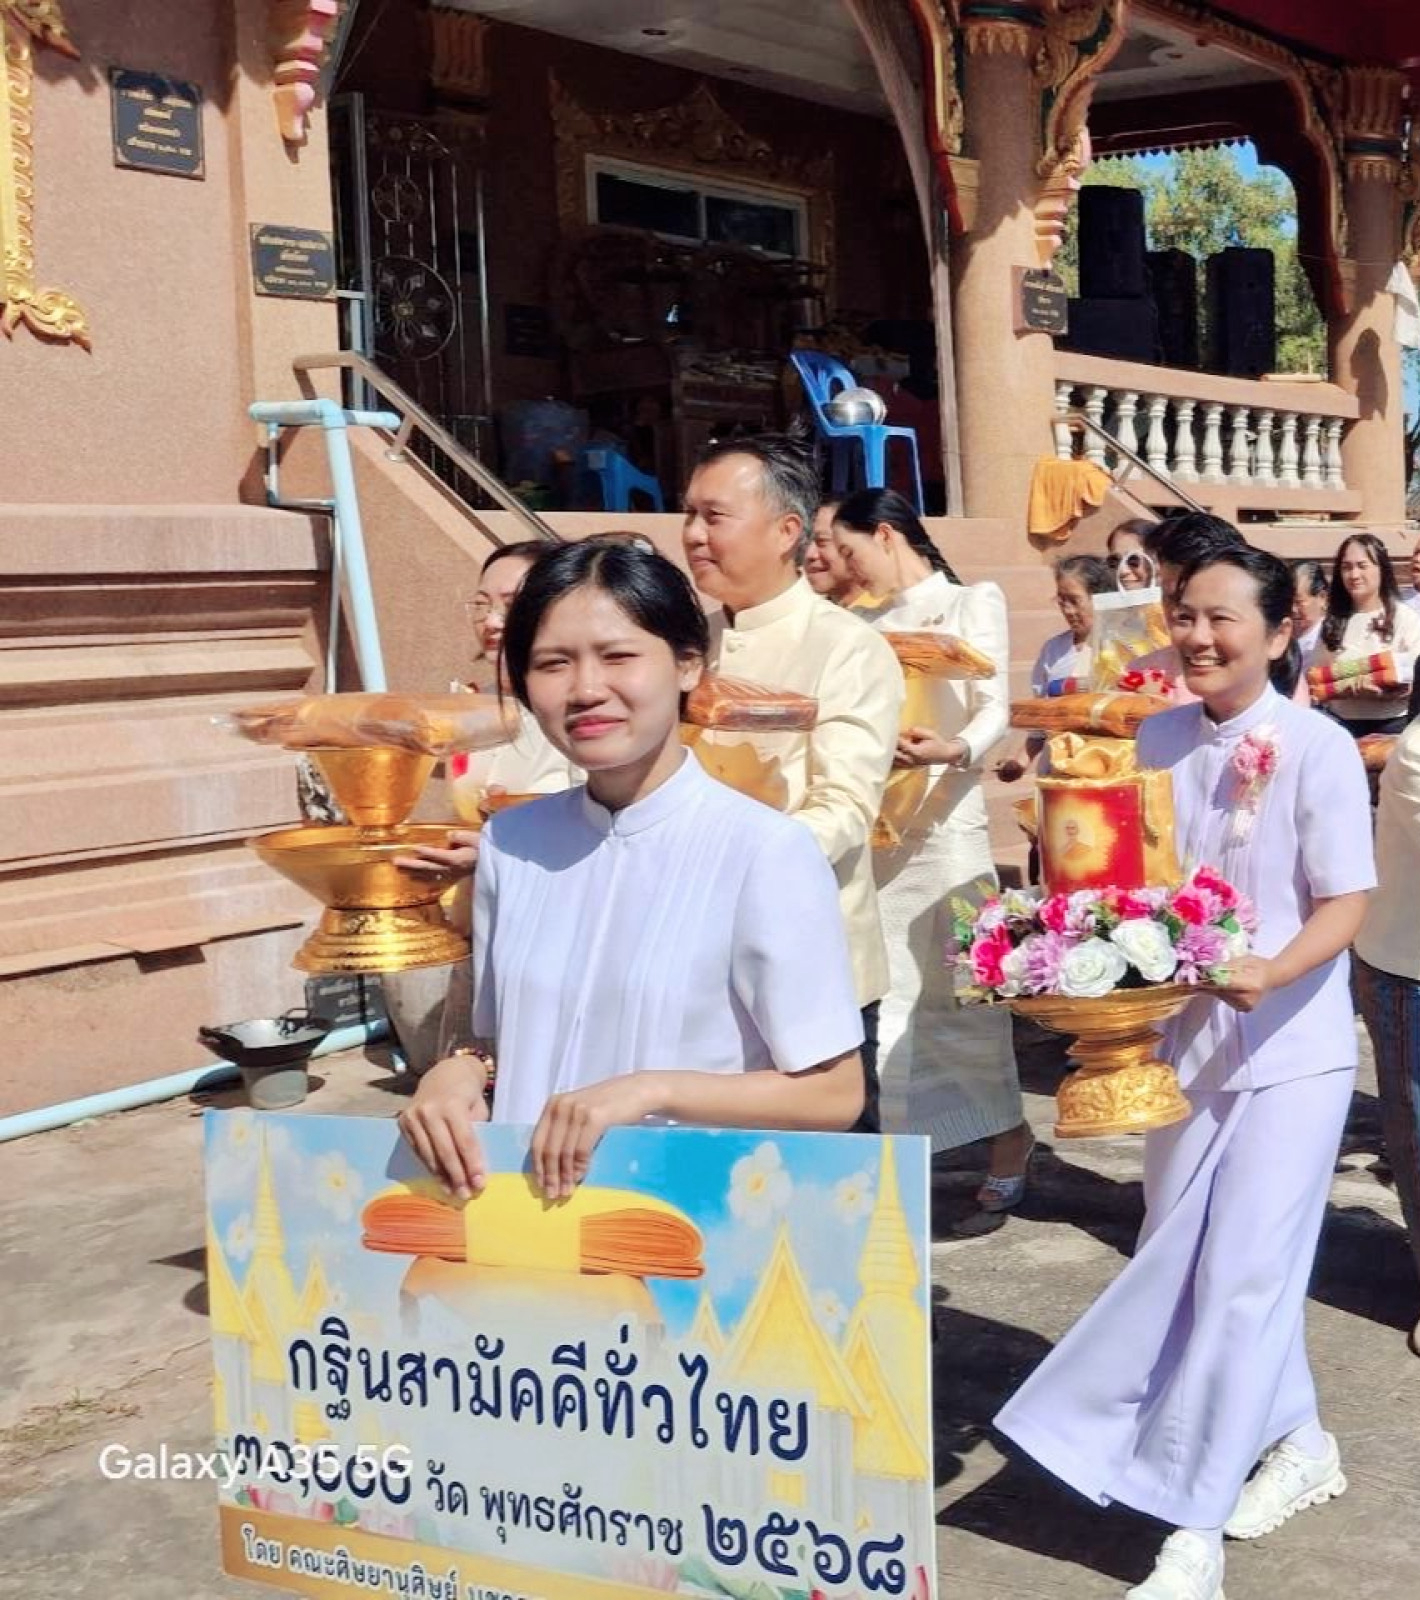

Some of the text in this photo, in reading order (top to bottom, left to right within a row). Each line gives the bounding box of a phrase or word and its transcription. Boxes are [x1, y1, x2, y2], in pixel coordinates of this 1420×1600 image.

[288, 1316, 808, 1461] กฐินสามัคคีทั่วไทย
[242, 1526, 281, 1565] โดย
[427, 1459, 469, 1517] วัด
[479, 1483, 683, 1556] พุทธศักราช
[701, 1503, 907, 1596] ๒๕๖๘
